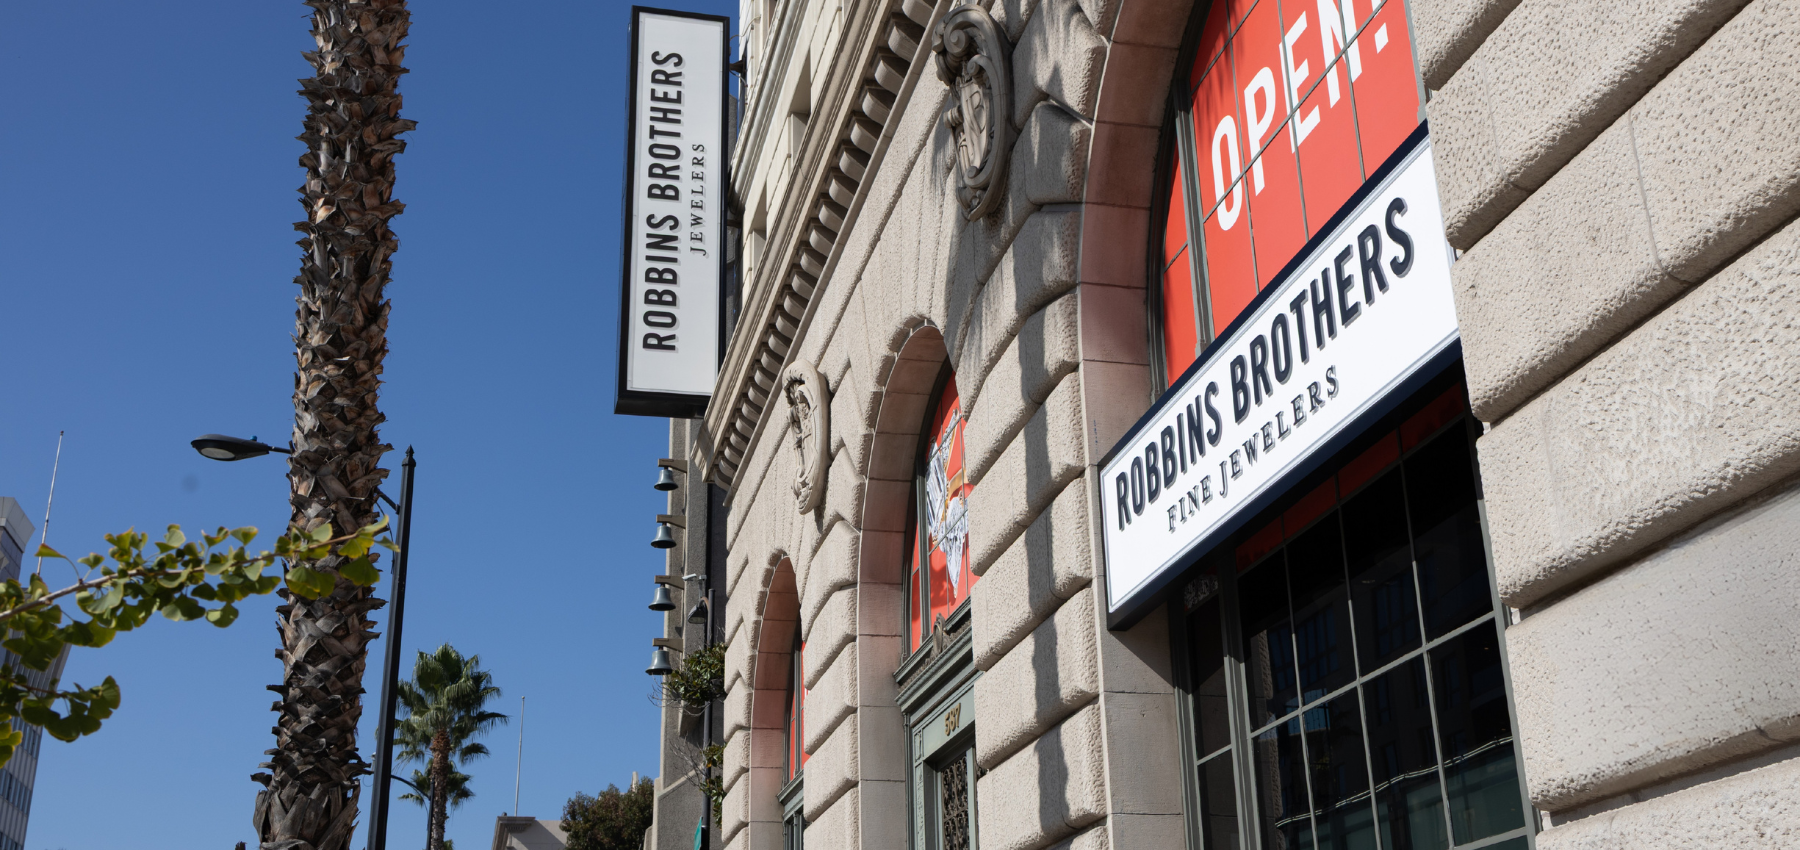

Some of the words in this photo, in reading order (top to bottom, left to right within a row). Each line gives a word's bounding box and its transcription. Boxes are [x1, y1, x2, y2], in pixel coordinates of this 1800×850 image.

[647, 50, 684, 201] BROTHERS
[690, 143, 708, 256] JEWELERS
[642, 213, 679, 351] ROBBINS
[1116, 381, 1222, 530] ROBBINS
[1230, 197, 1414, 423] BROTHERS
[1167, 475, 1213, 532] FINE
[1219, 366, 1340, 498] JEWELERS
[945, 703, 961, 736] 587
